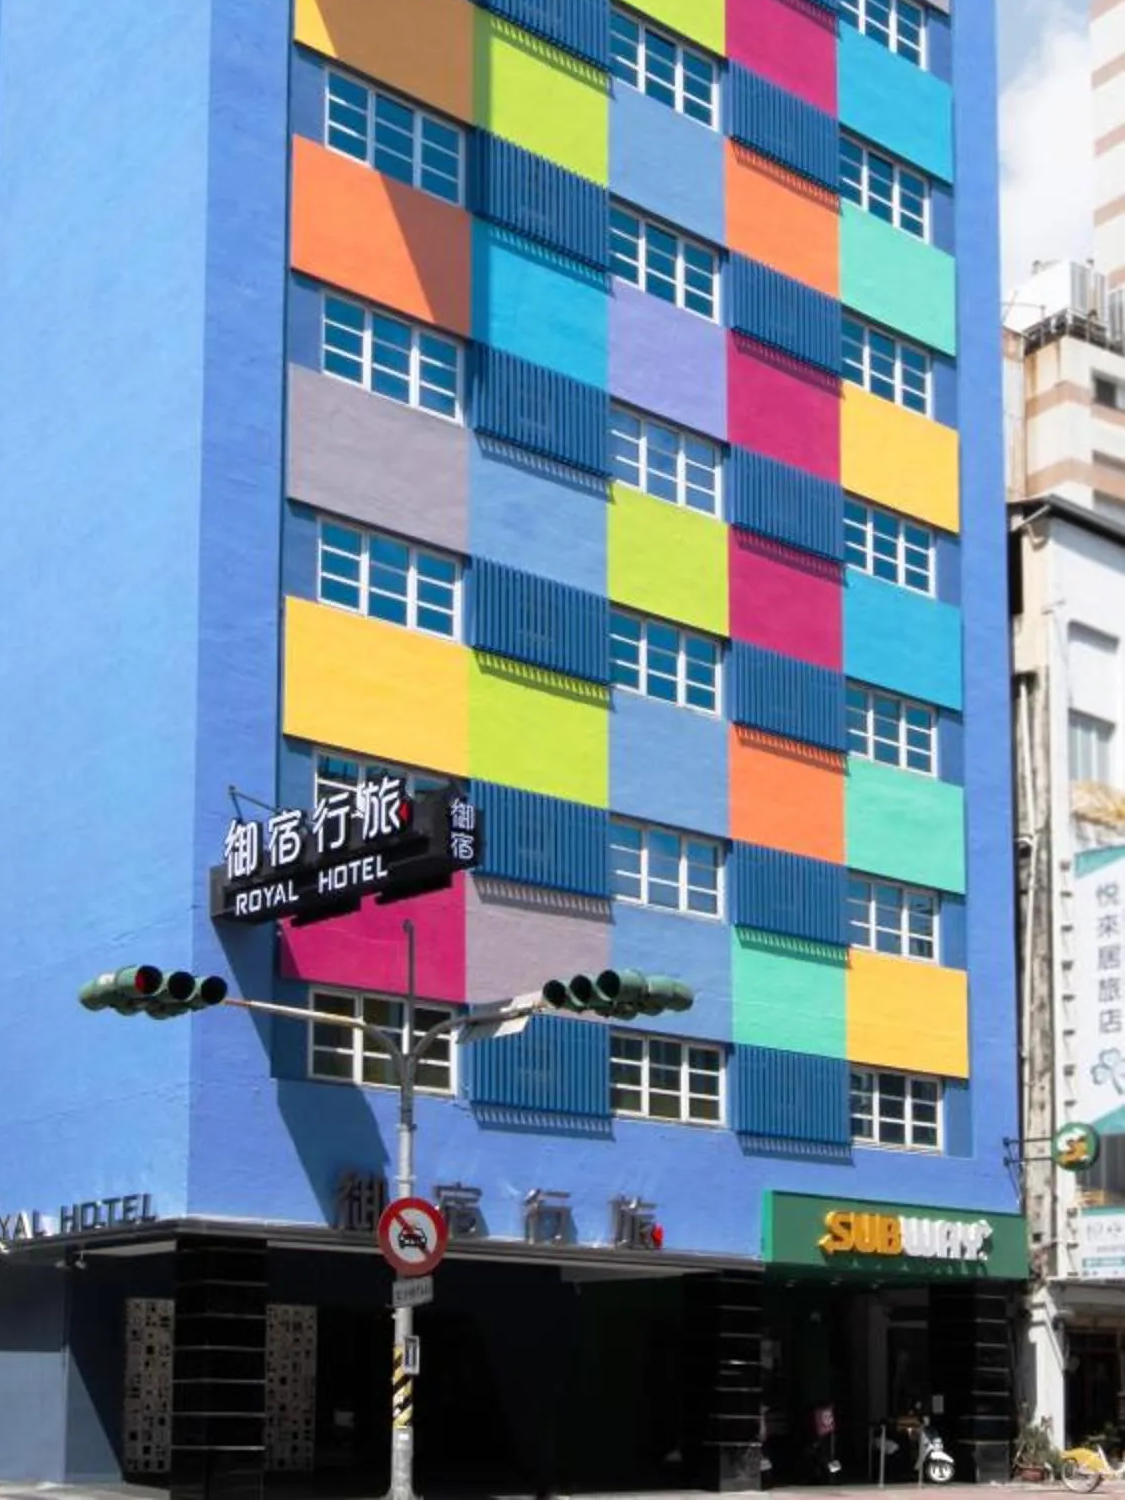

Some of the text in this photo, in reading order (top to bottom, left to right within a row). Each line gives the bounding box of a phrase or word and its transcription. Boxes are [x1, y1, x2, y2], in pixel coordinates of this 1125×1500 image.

[225, 776, 401, 879] 御宿行旅
[450, 798, 475, 859] 御宿
[234, 855, 388, 916] ROYAL HOTEL
[60, 1193, 157, 1232] HOTEL
[818, 1211, 993, 1260] SUBWAY
